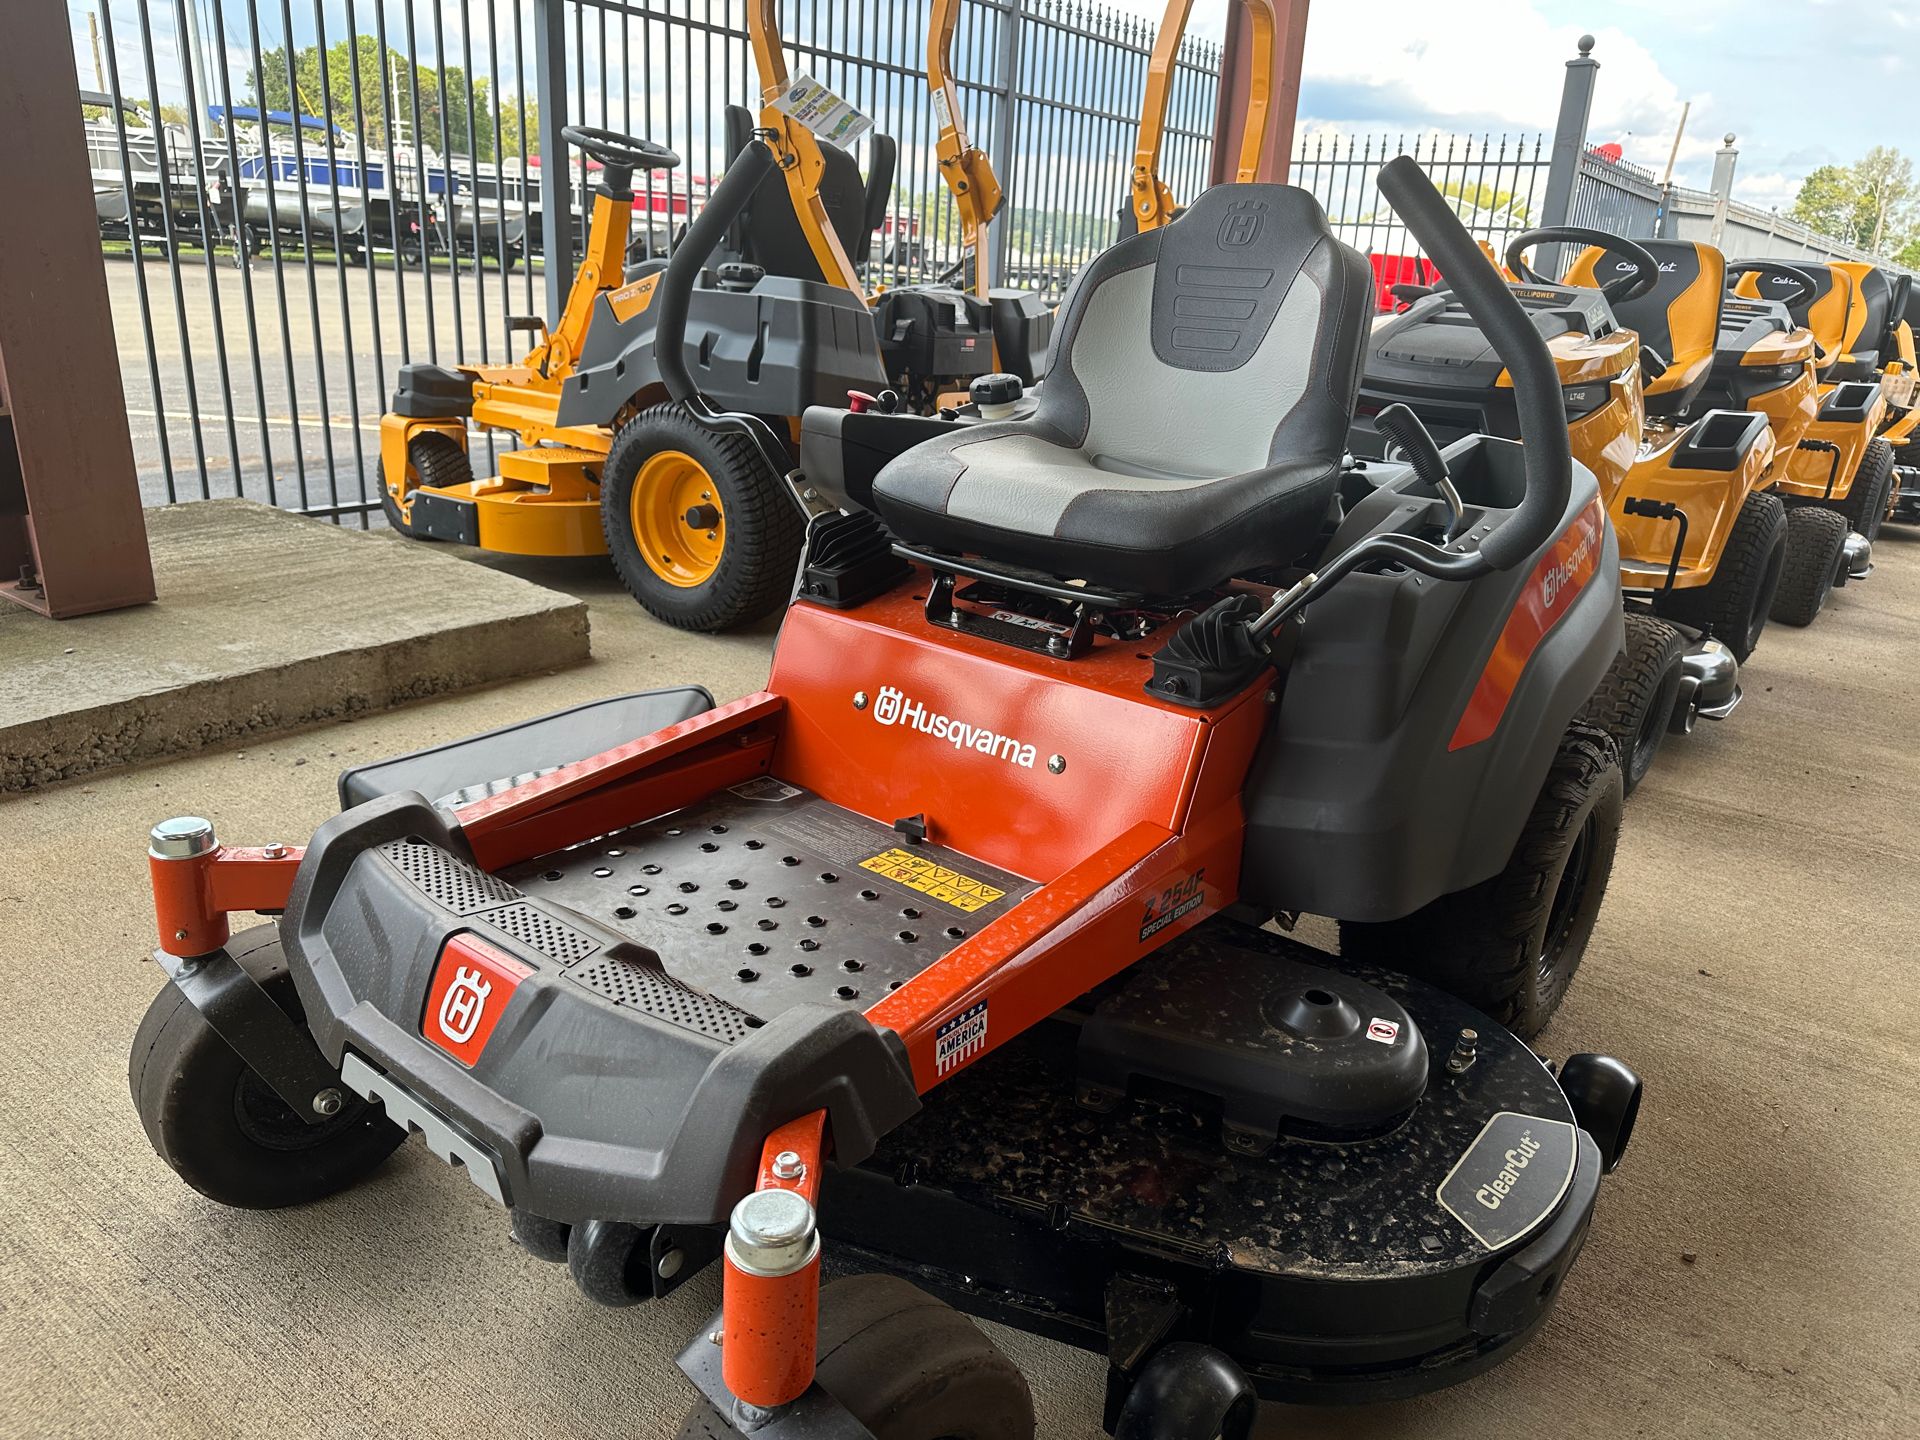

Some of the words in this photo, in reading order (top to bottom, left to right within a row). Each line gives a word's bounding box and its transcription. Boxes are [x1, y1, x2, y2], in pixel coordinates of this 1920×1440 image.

[612, 293, 630, 304] PRO
[636, 282, 651, 294] 100
[1569, 392, 1586, 401] LT42
[1555, 525, 1596, 593] Husqvarna
[899, 698, 1037, 769] Husqvarna
[1141, 912, 1173, 939] SPECIAL
[1173, 892, 1204, 919] EDITION
[1142, 895, 1157, 923] Z
[1160, 867, 1206, 913] 254F
[939, 1025, 963, 1046] PROUDLY
[964, 1016, 979, 1030] BUILT
[939, 1019, 985, 1058] AMERICA
